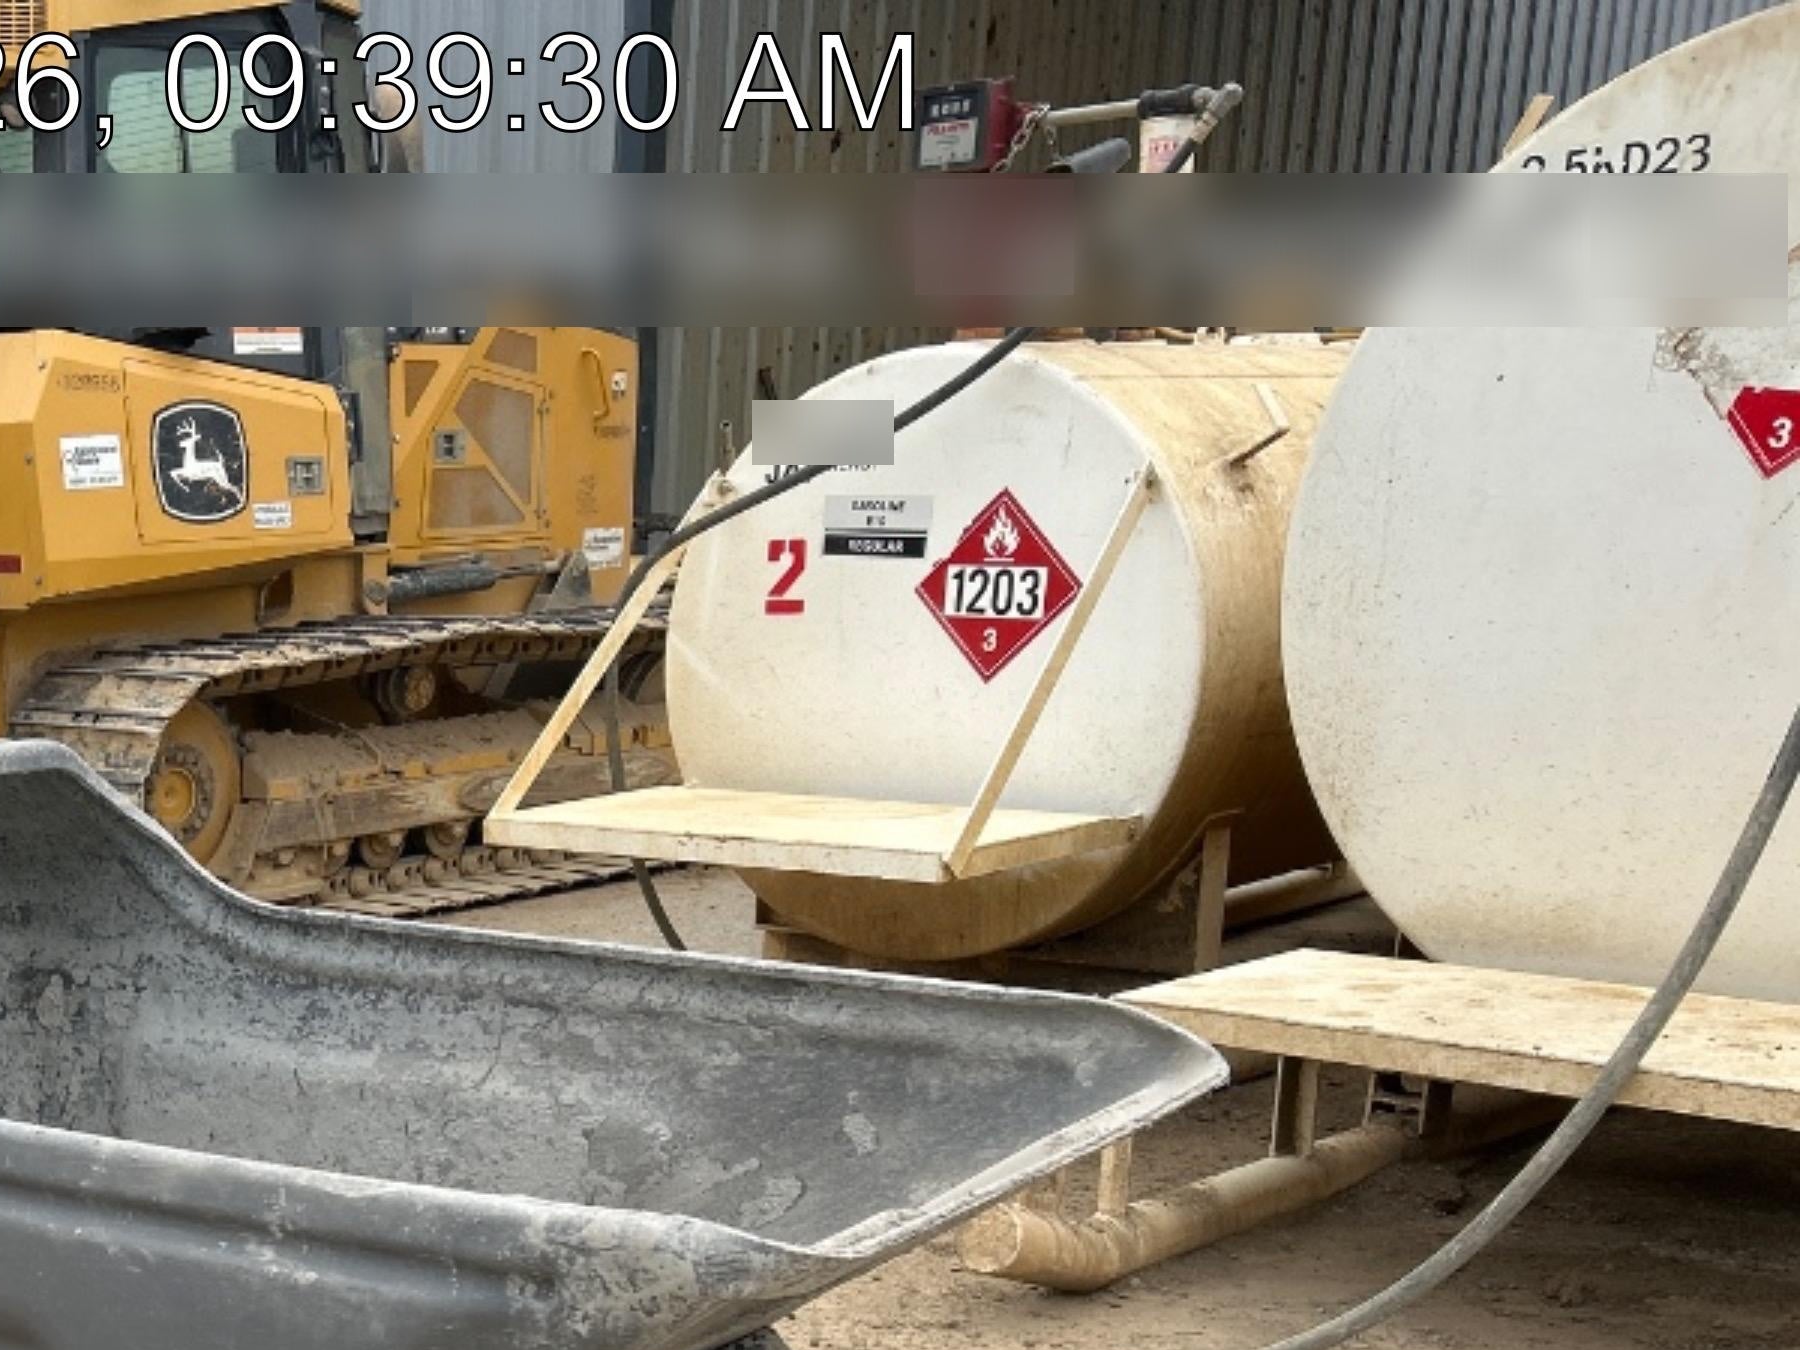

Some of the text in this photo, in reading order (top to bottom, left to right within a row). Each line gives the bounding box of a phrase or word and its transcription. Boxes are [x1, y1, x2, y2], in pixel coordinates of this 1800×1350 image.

[1767, 416, 1794, 449] 3
[765, 538, 807, 616] 2
[952, 568, 1041, 616] 1203
[982, 627, 998, 652] 3
